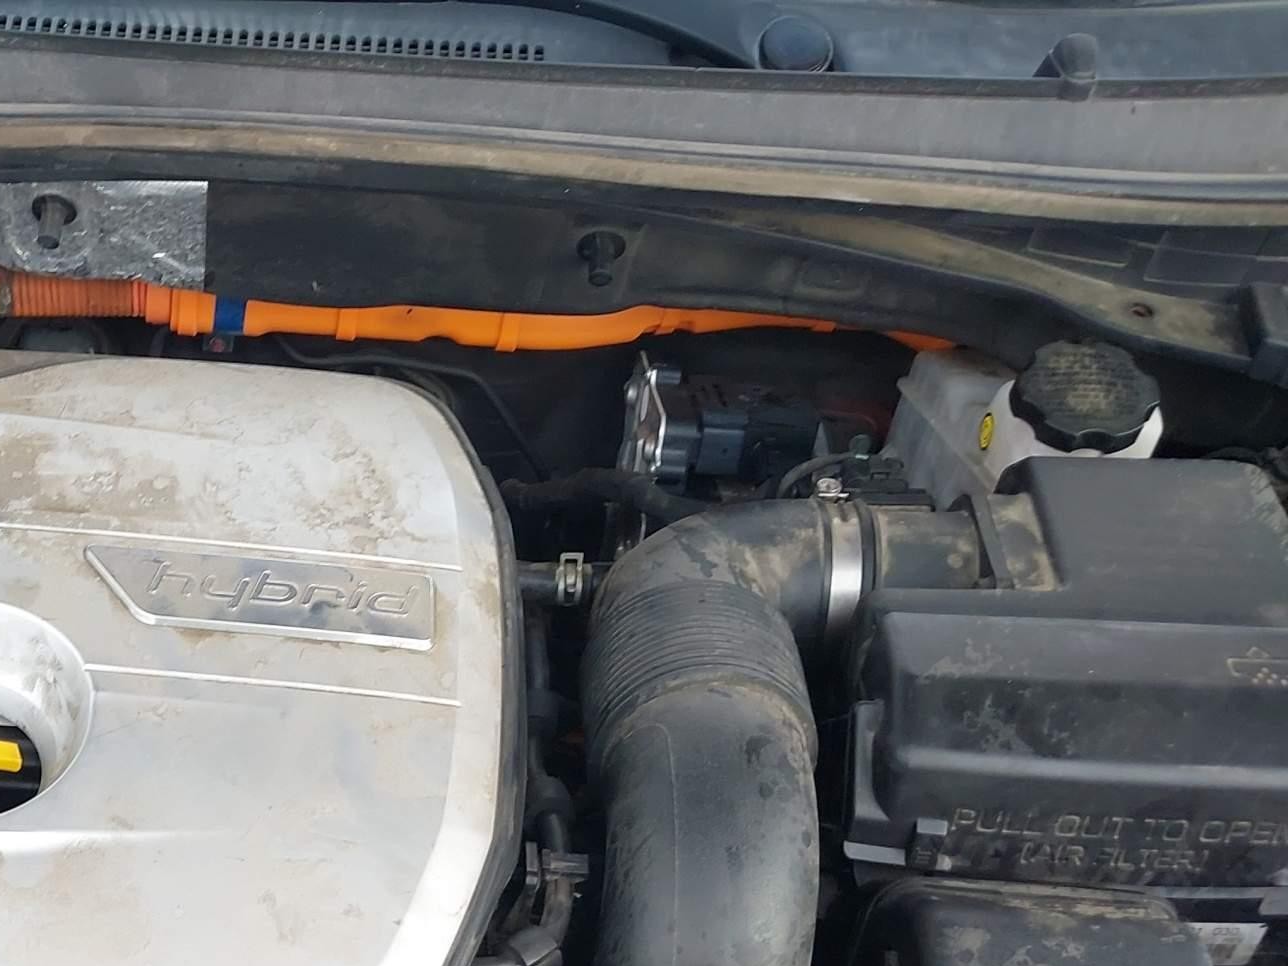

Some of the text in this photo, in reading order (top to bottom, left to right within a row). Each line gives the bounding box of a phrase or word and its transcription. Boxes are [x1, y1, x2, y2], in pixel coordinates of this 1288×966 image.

[146, 558, 417, 617] hybrid
[950, 808, 1041, 837] PULL
[1054, 815, 1134, 840] OUT
[1144, 818, 1189, 843] TO
